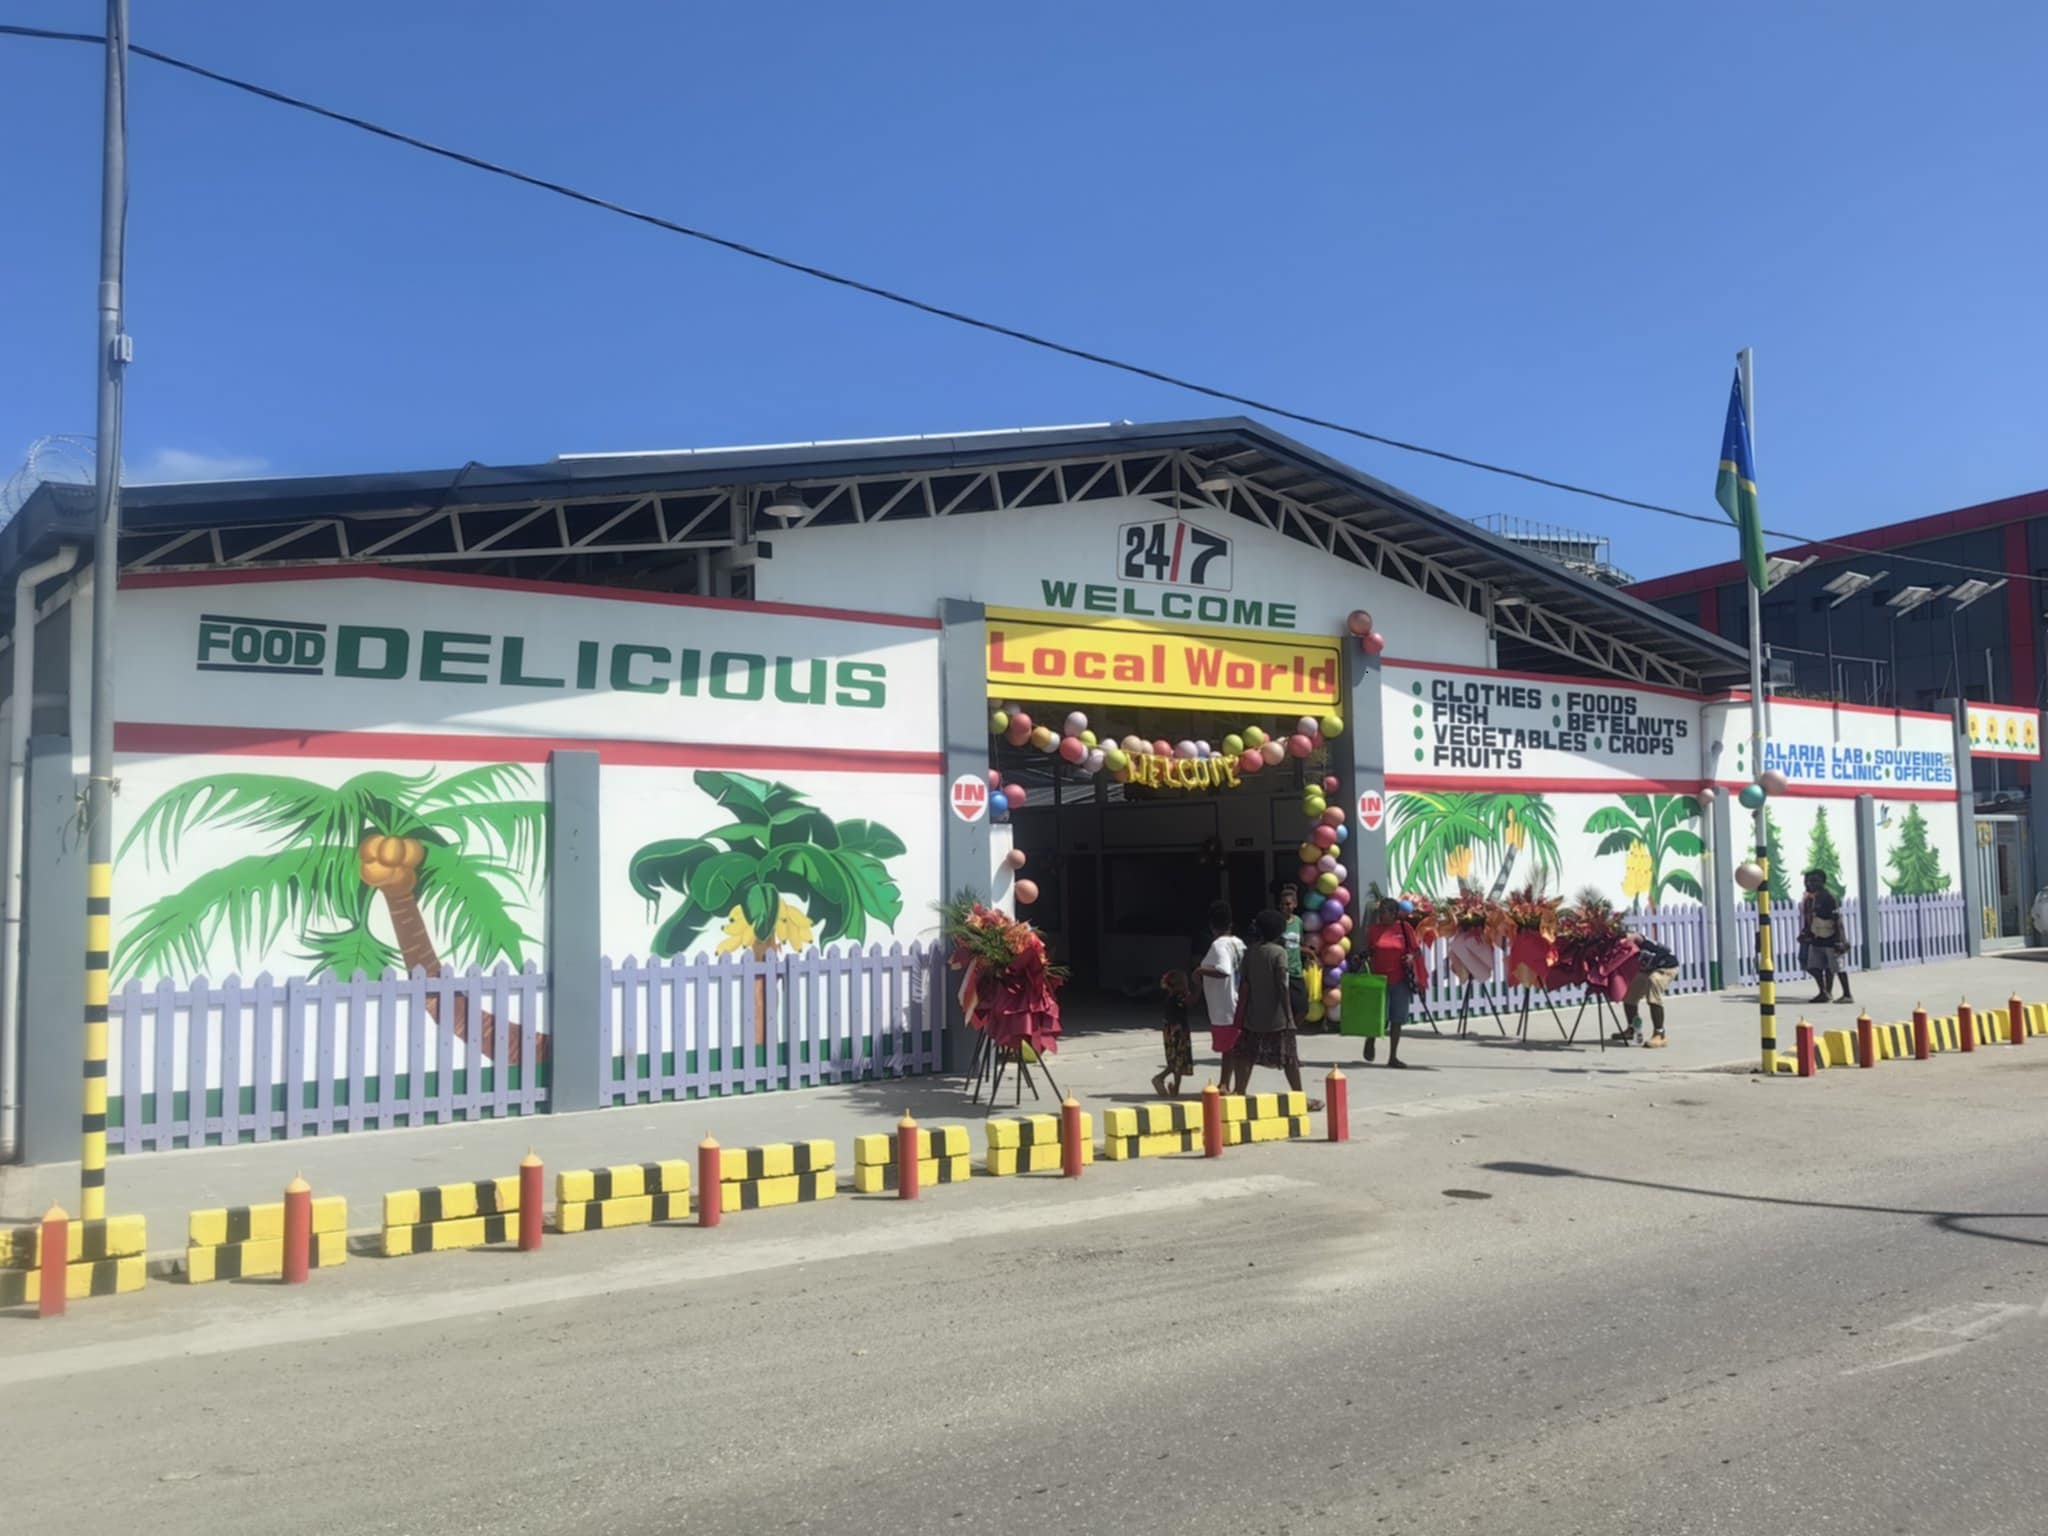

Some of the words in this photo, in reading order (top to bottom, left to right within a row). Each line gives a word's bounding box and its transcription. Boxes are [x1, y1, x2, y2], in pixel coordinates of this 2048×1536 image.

[1123, 521, 1228, 585] 24/7
[1042, 579, 1297, 629] WELCOME
[197, 622, 327, 667] FOOD
[334, 625, 887, 708] DELICIOUS
[989, 631, 1166, 684] Local
[1184, 646, 1336, 696] World
[1431, 679, 1543, 711] CLOTHES
[1567, 691, 1638, 716] FOODS
[1432, 702, 1489, 725] FISH
[1567, 713, 1688, 738] BETELNUTS
[1433, 744, 1523, 769] FRUITS
[1434, 723, 1588, 753] VEGETABLES
[1608, 735, 1675, 756] CROPS
[1765, 742, 1825, 762] ALARIA
[1832, 746, 1863, 764] LAB
[1124, 753, 1241, 790] WELCOME
[1832, 762, 1882, 781] CLINIC
[1894, 766, 1952, 783] OFFICES
[954, 783, 985, 801] IN
[1361, 797, 1381, 812] IN
